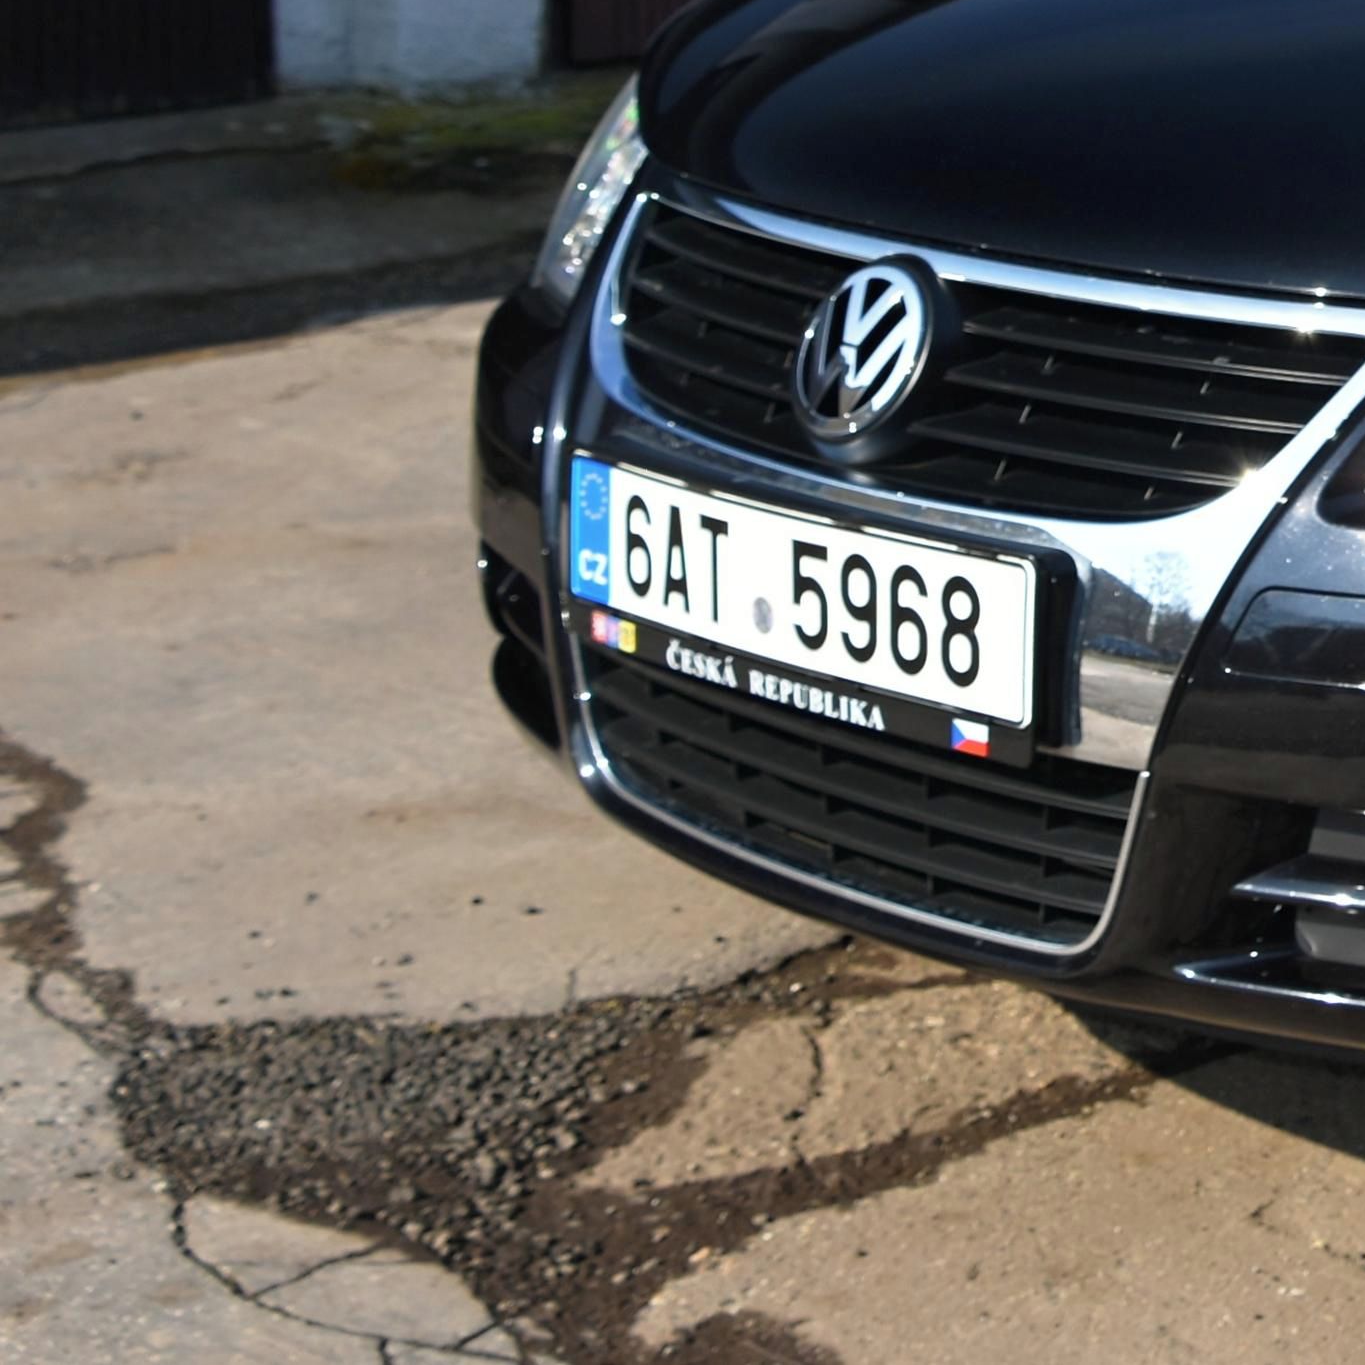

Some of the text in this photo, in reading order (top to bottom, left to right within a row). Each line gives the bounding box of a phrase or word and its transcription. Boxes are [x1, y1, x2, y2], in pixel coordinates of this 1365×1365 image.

[578, 547, 609, 585] CZ
[625, 494, 981, 687] 6AT 5968
[664, 639, 886, 731] ČESKÁ REPUBLIKA
